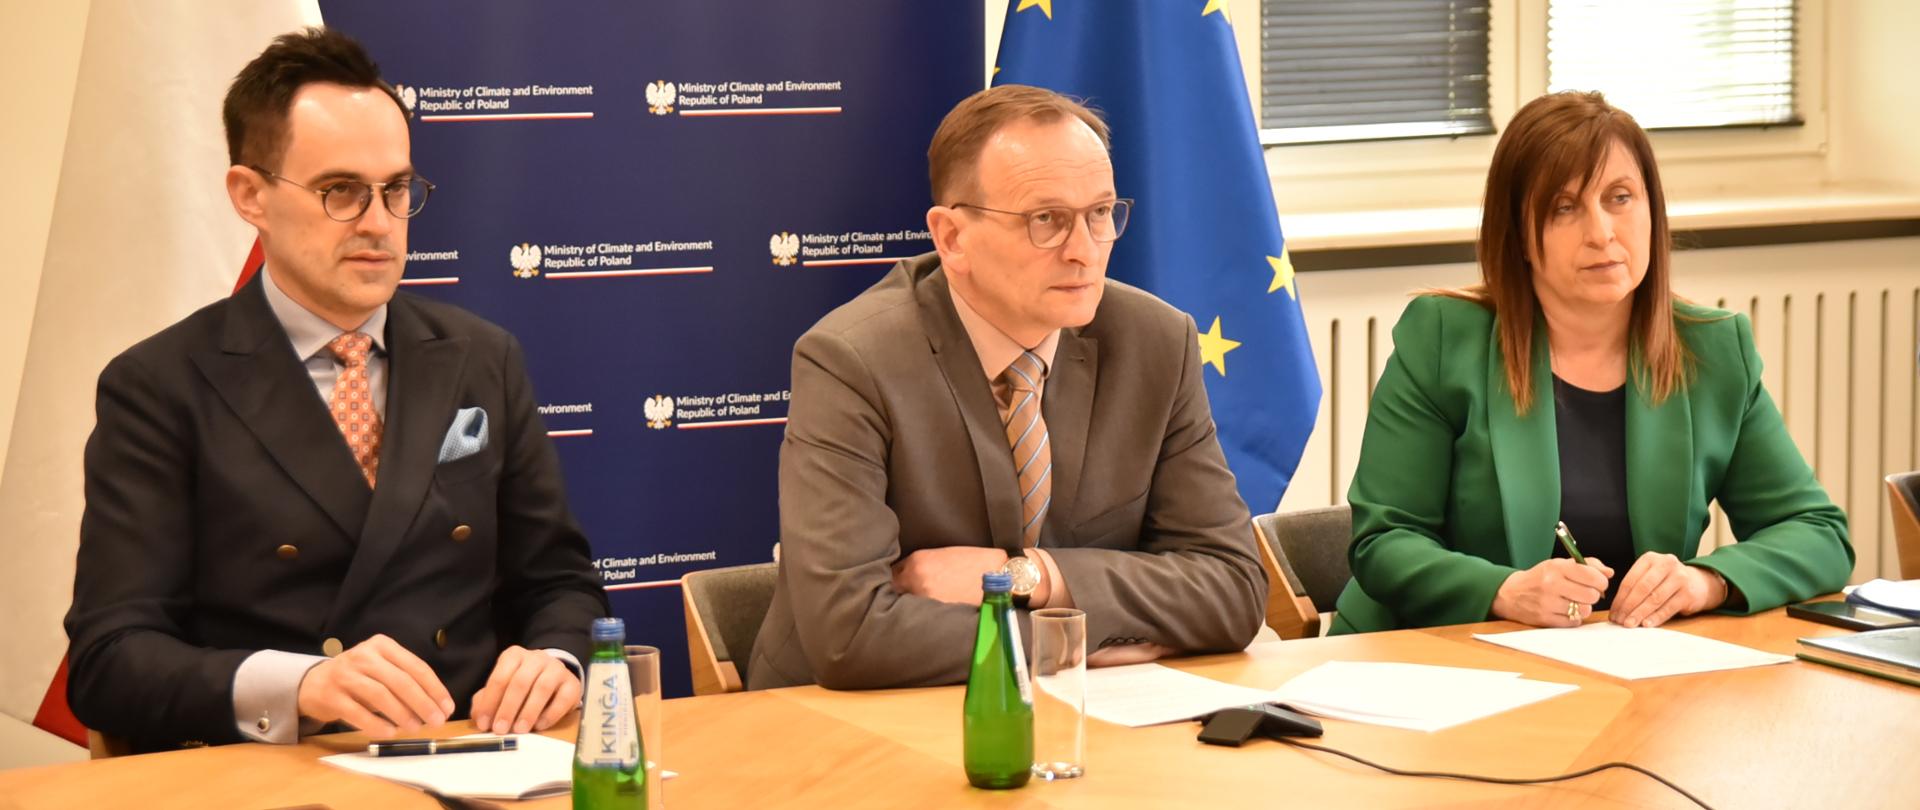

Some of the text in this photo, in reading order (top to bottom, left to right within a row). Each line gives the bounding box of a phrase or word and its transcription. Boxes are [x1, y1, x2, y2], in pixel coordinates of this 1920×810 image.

[420, 85, 593, 99] Ministry of Climate and Environment
[679, 81, 841, 94] Ministry of Climate and Environment
[420, 99, 509, 112] Republic of Poland
[679, 94, 762, 106] Republic of Poland
[802, 230, 933, 245] Ministry of Climate and Enviro
[406, 250, 459, 261] vironment
[544, 241, 712, 256] Ministry of Climate and Environment
[802, 244, 882, 257] Republic of Poland
[545, 256, 632, 270] Republic of Poland
[677, 396, 714, 406] Ministry
[716, 395, 726, 404] of
[728, 394, 761, 403] Climate
[763, 392, 780, 400] and
[538, 402, 592, 414] nvironment
[677, 405, 760, 419] Republic of Poland
[602, 558, 637, 569] Climate
[639, 554, 656, 565] and
[658, 551, 716, 564] Environment
[604, 569, 635, 580] Poland
[600, 674, 618, 754] KINGA
